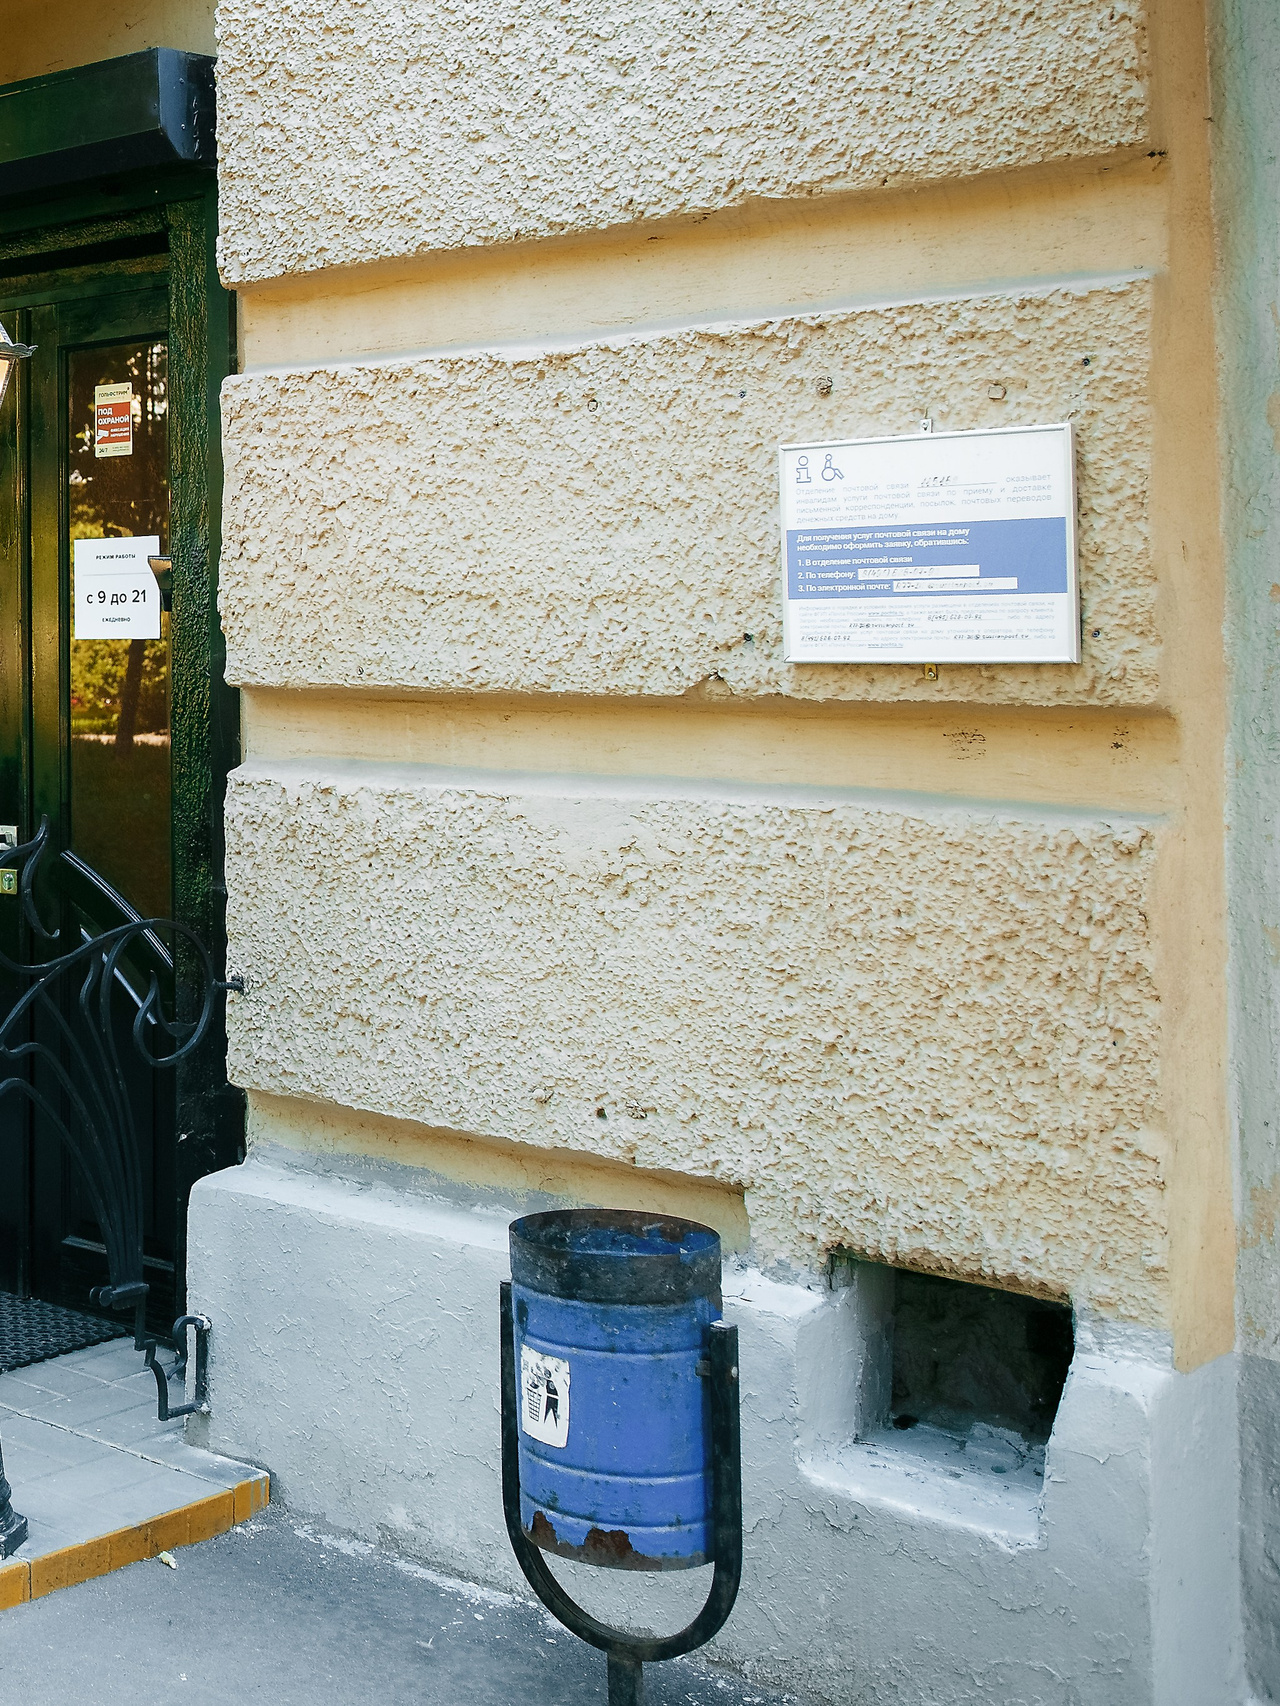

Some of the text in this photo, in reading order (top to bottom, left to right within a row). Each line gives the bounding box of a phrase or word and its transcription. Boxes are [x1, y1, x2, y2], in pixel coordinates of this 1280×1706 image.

[99, 390, 128, 398] ГОЛЬФСТРИМ
[98, 415, 129, 425] ОХРАНОЙ
[843, 484, 878, 492] почтовой
[1006, 474, 1051, 482] оказывает
[874, 491, 910, 500] почтовой
[964, 488, 993, 496] приему
[1012, 485, 1051, 493] доставке
[796, 506, 840, 514] письменной
[846, 502, 915, 512] корреспонденции,
[1007, 494, 1051, 503] переводов
[797, 516, 833, 524] денежных
[836, 514, 865, 522] средств
[797, 534, 812, 543] Для
[813, 533, 851, 543] получения
[853, 533, 873, 541] услуг
[875, 530, 911, 538] почтовой
[948, 528, 970, 536] дому
[797, 538, 969, 551] необходимо оформить заявку, обратившись:
[853, 556, 888, 564] почтовой
[817, 571, 856, 579] телефону:
[818, 583, 865, 592] электронной
[87, 590, 146, 605] с 9 до 21
